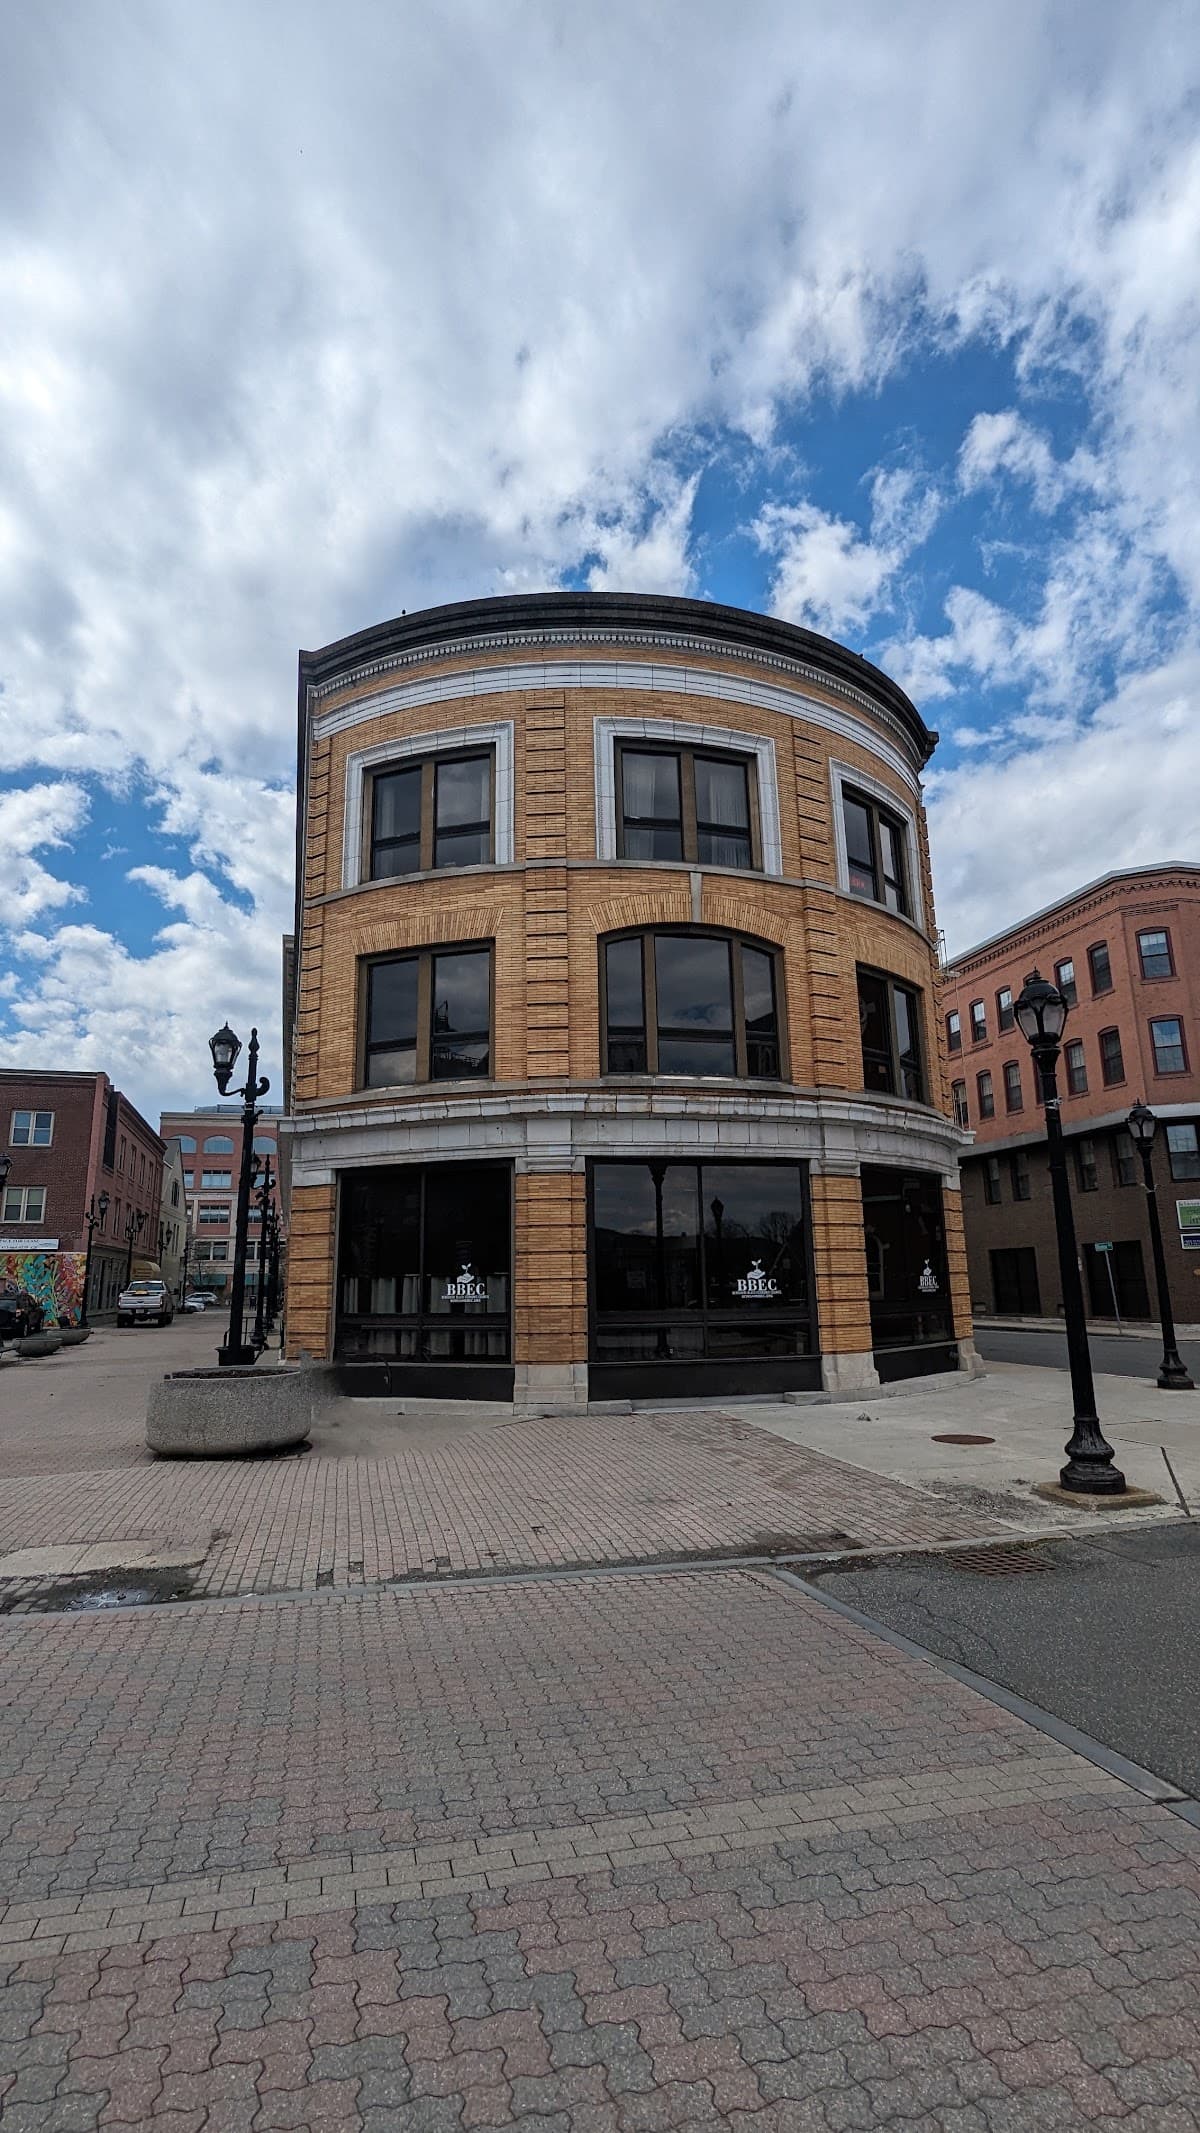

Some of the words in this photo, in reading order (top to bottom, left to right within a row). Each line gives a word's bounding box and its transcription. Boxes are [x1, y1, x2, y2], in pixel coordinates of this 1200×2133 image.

[737, 1279, 777, 1290] BBEC
[920, 1275, 937, 1286] BBEC
[447, 1283, 485, 1295] BBEC
